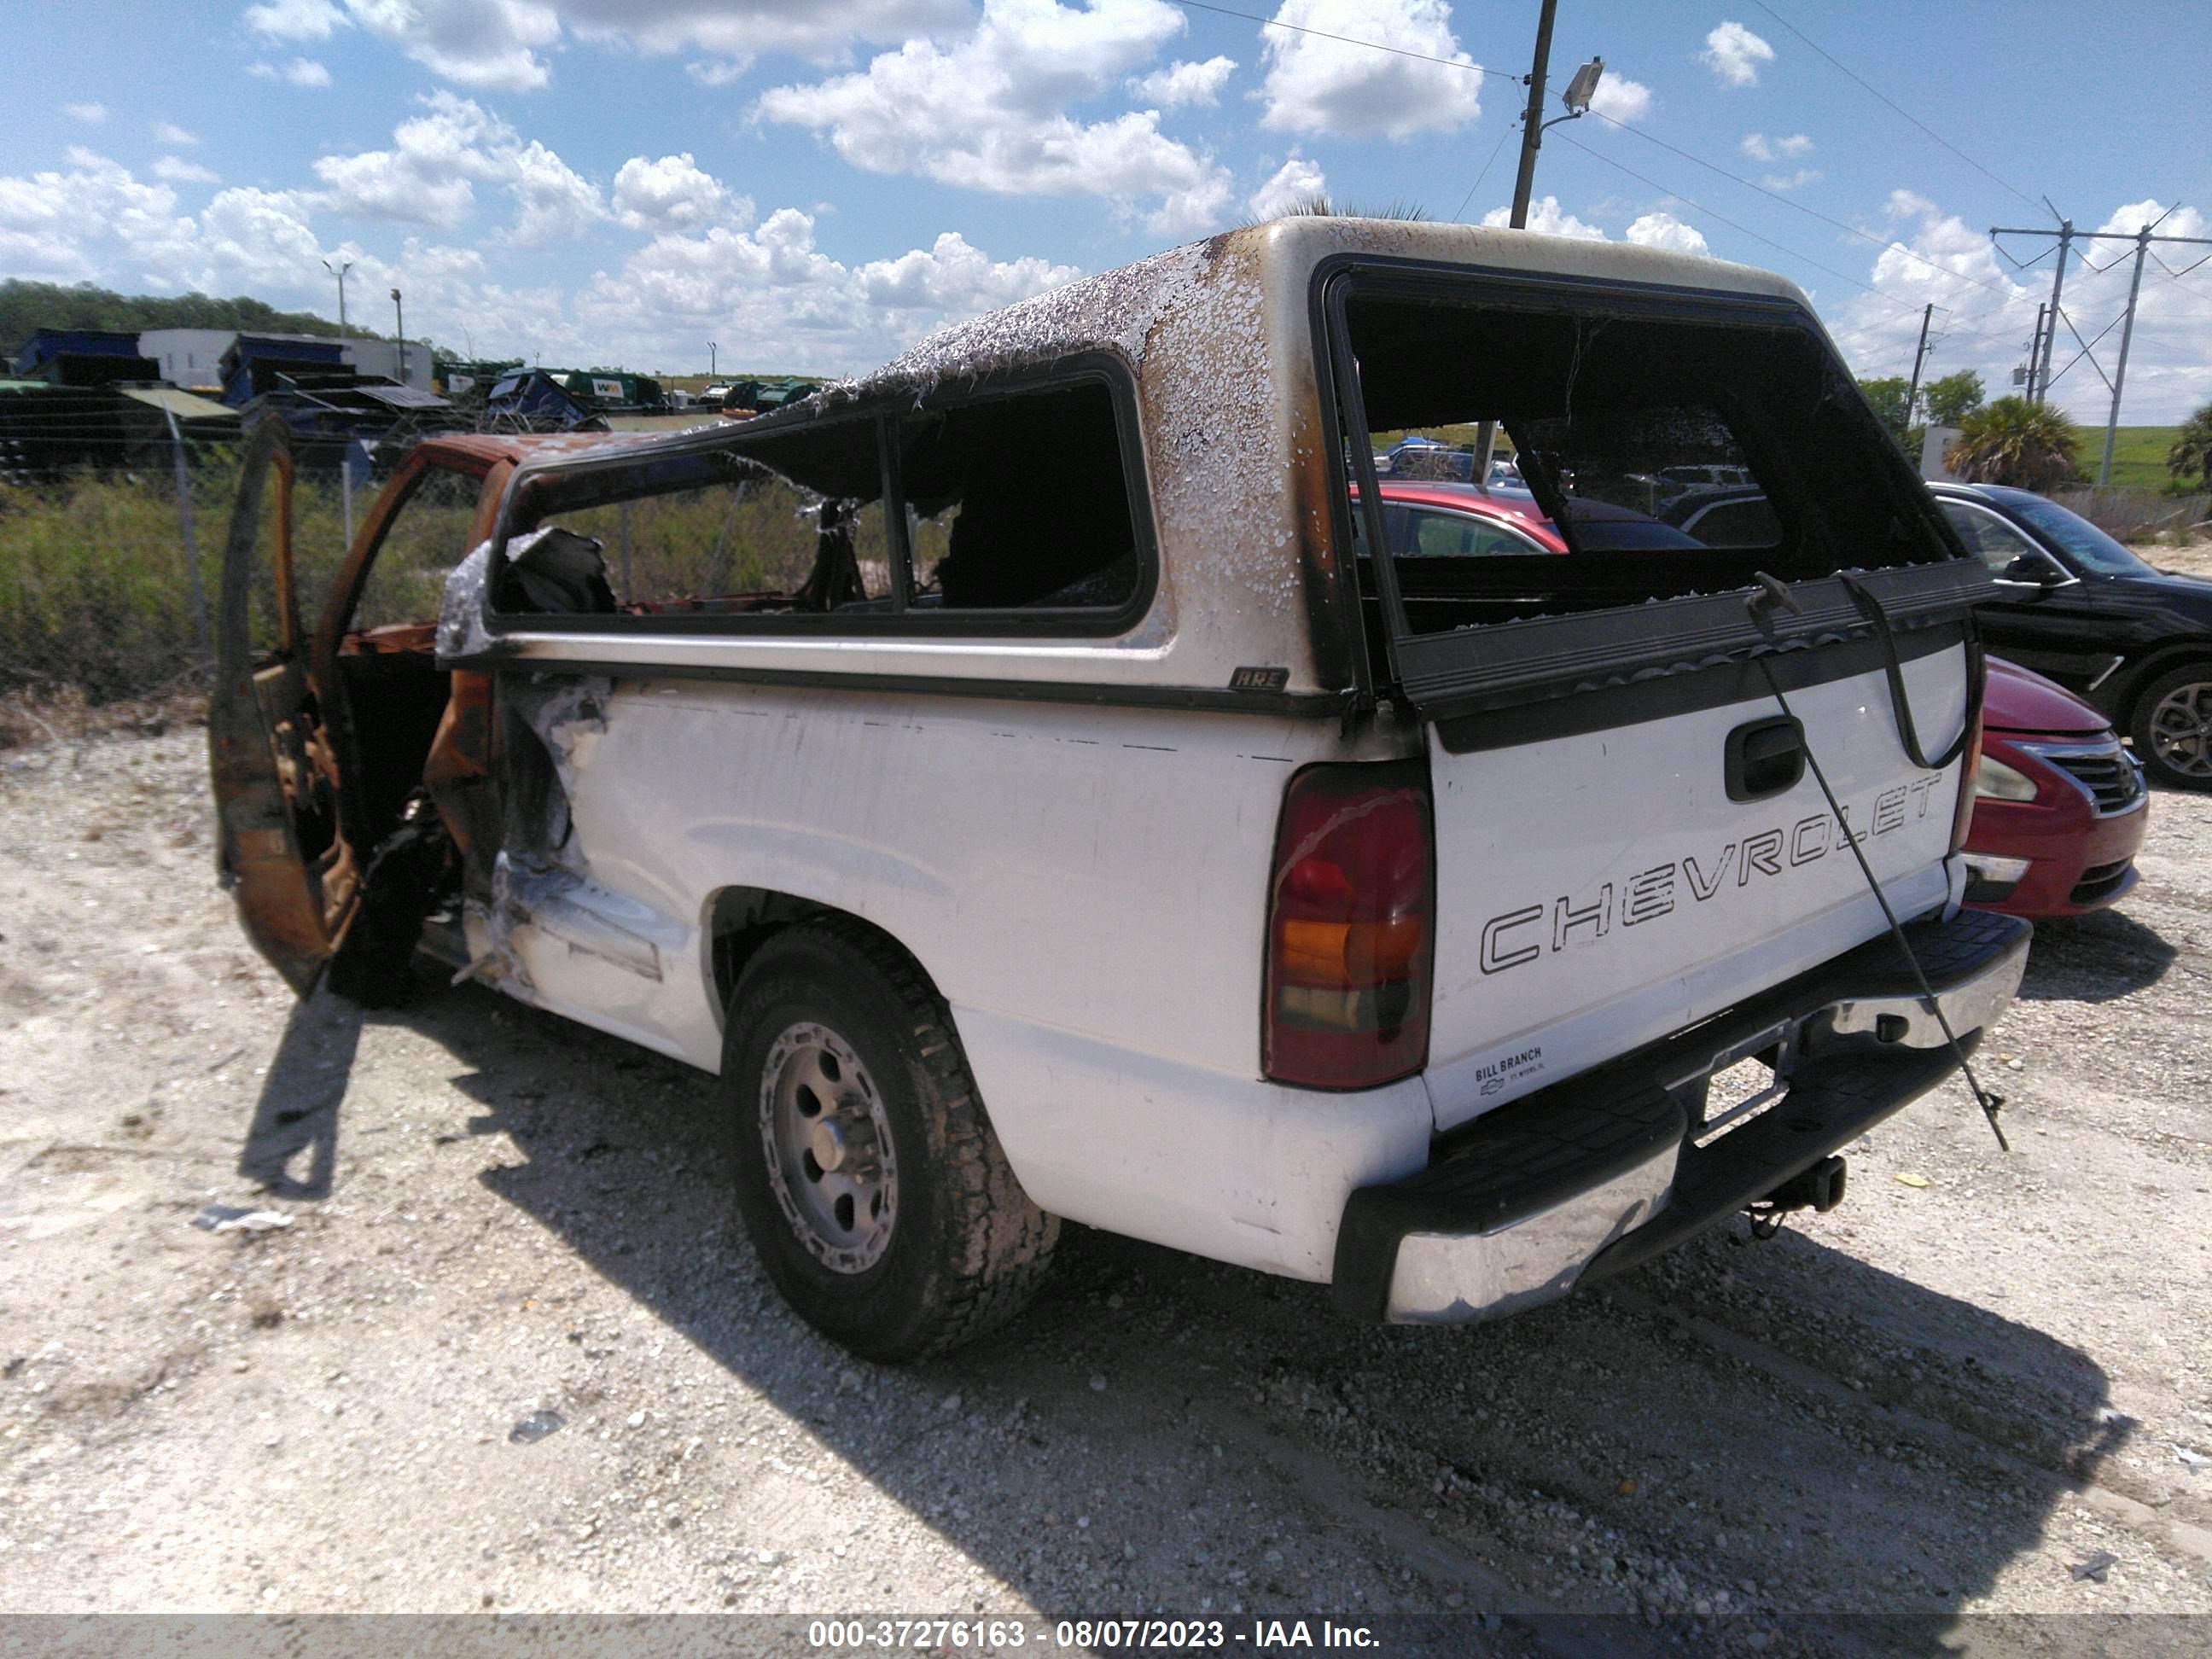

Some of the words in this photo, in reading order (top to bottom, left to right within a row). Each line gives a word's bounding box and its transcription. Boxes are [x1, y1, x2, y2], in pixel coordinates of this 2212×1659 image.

[1480, 771, 1941, 975] CHEVROLET
[1476, 1064, 1498, 1082] BILL
[1500, 1046, 1542, 1072] BRANCH
